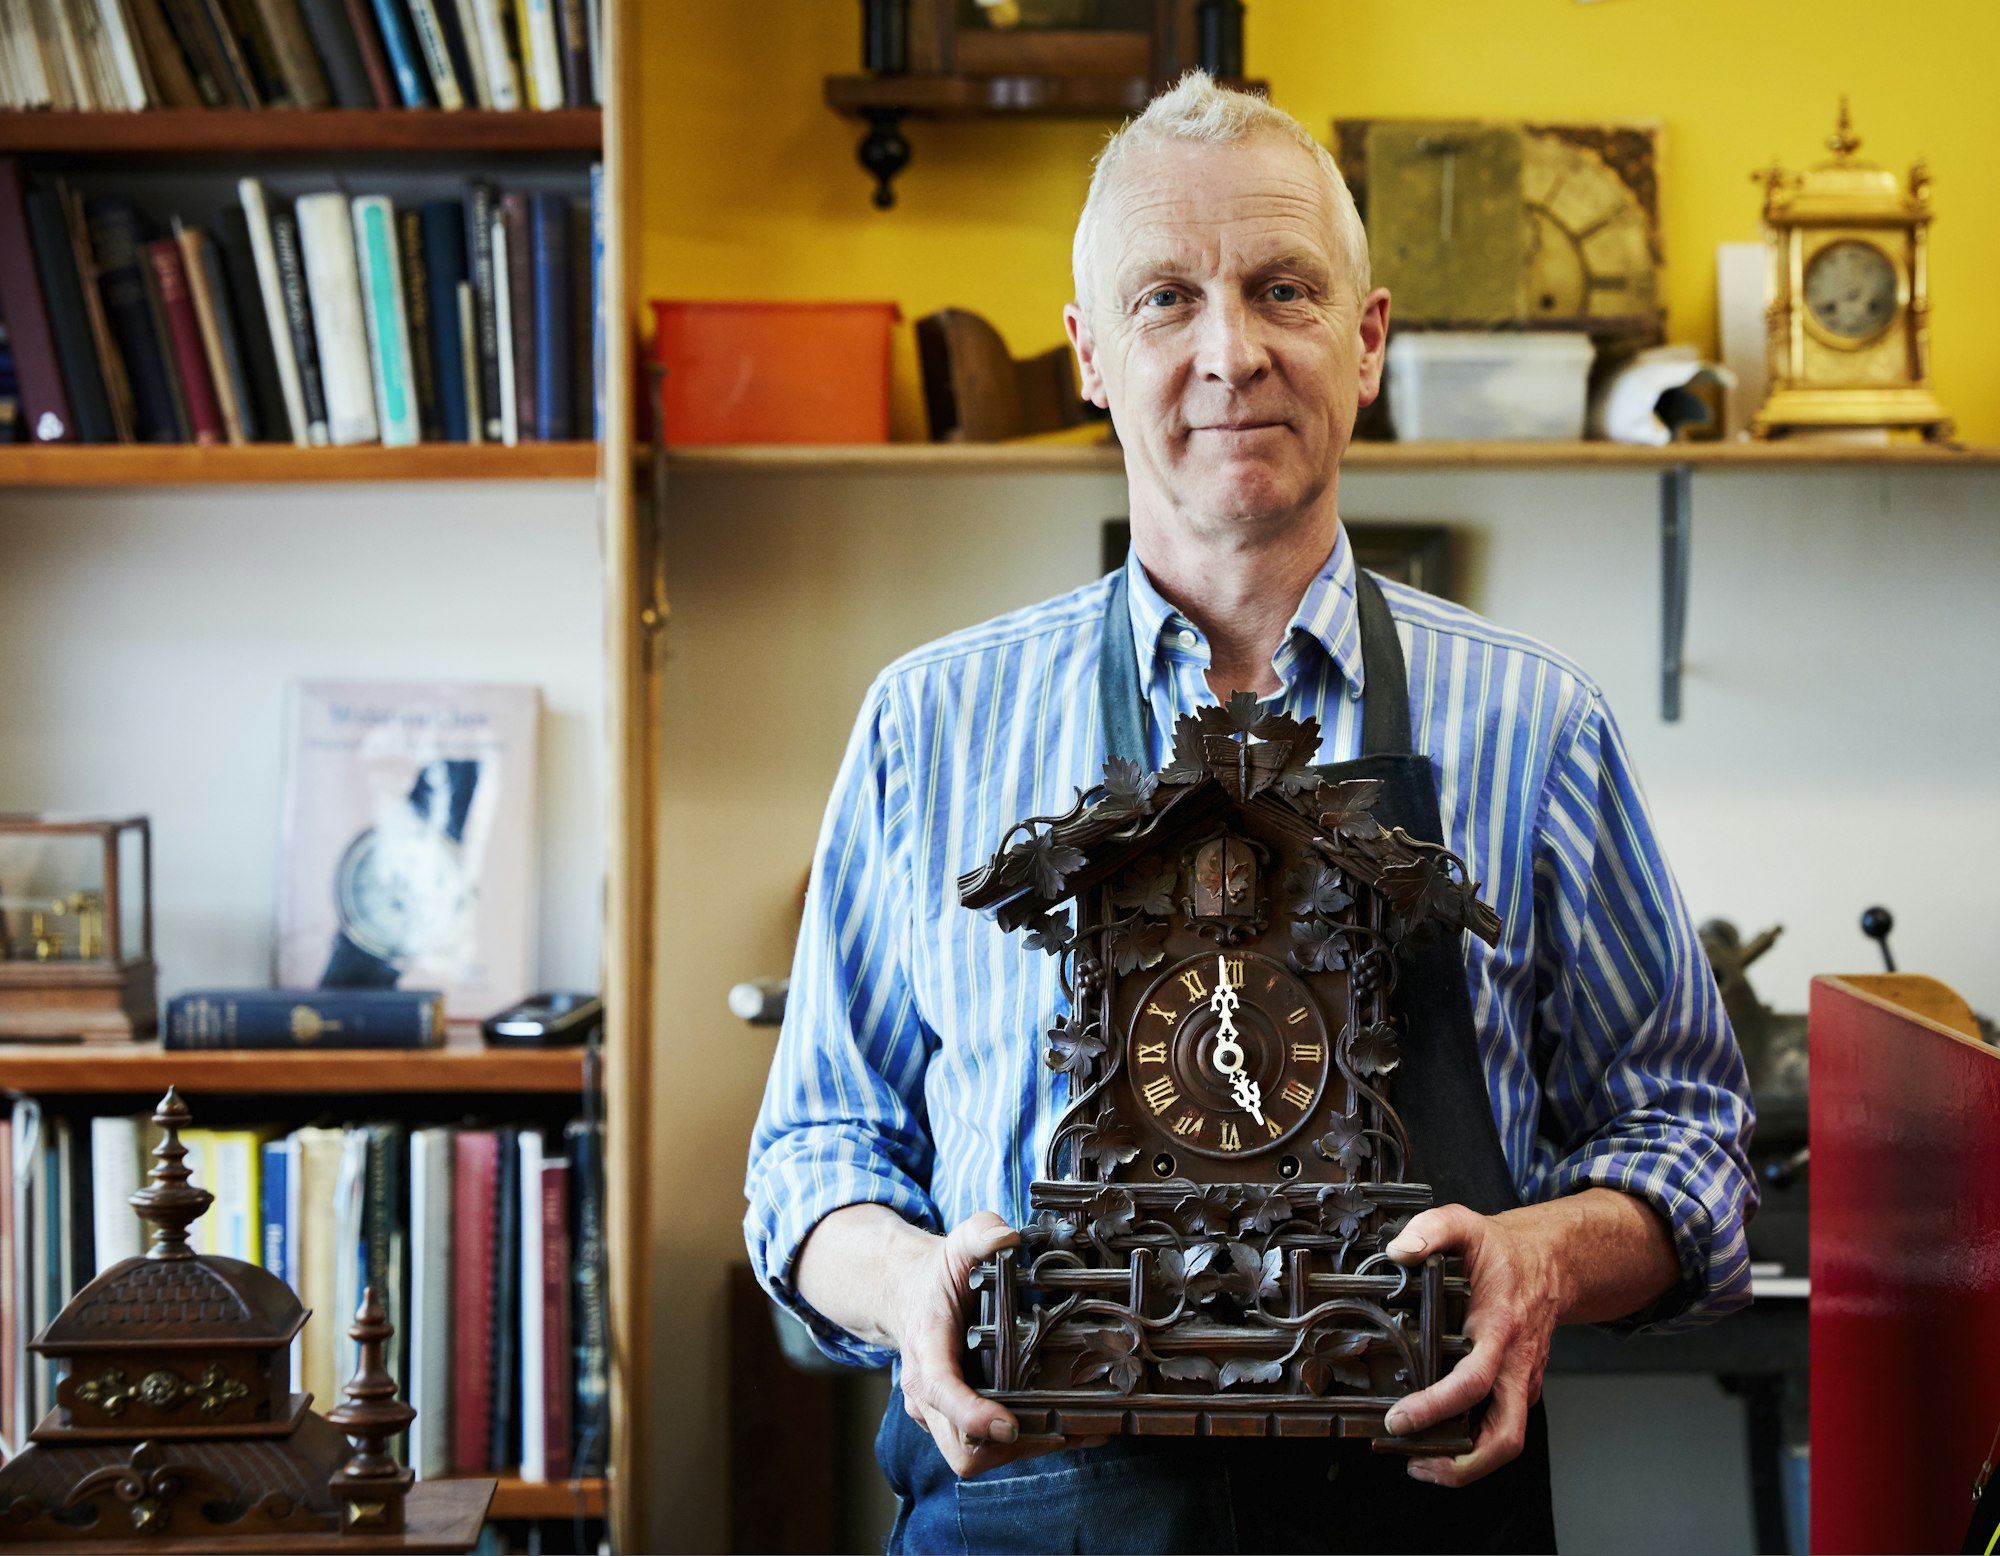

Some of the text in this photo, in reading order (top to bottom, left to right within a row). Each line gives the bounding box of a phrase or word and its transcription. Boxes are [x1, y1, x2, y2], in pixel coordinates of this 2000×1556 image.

[1177, 969, 1208, 1004] XI
[1146, 1002, 1178, 1026] X
[1136, 1041, 1168, 1065] IX
[1290, 1042, 1323, 1064] III
[1142, 1074, 1181, 1117] VIII
[1281, 1079, 1316, 1112] IIII
[1172, 1113, 1206, 1138] VII
[1219, 1119, 1243, 1152] VI
[1263, 1113, 1283, 1140] V
